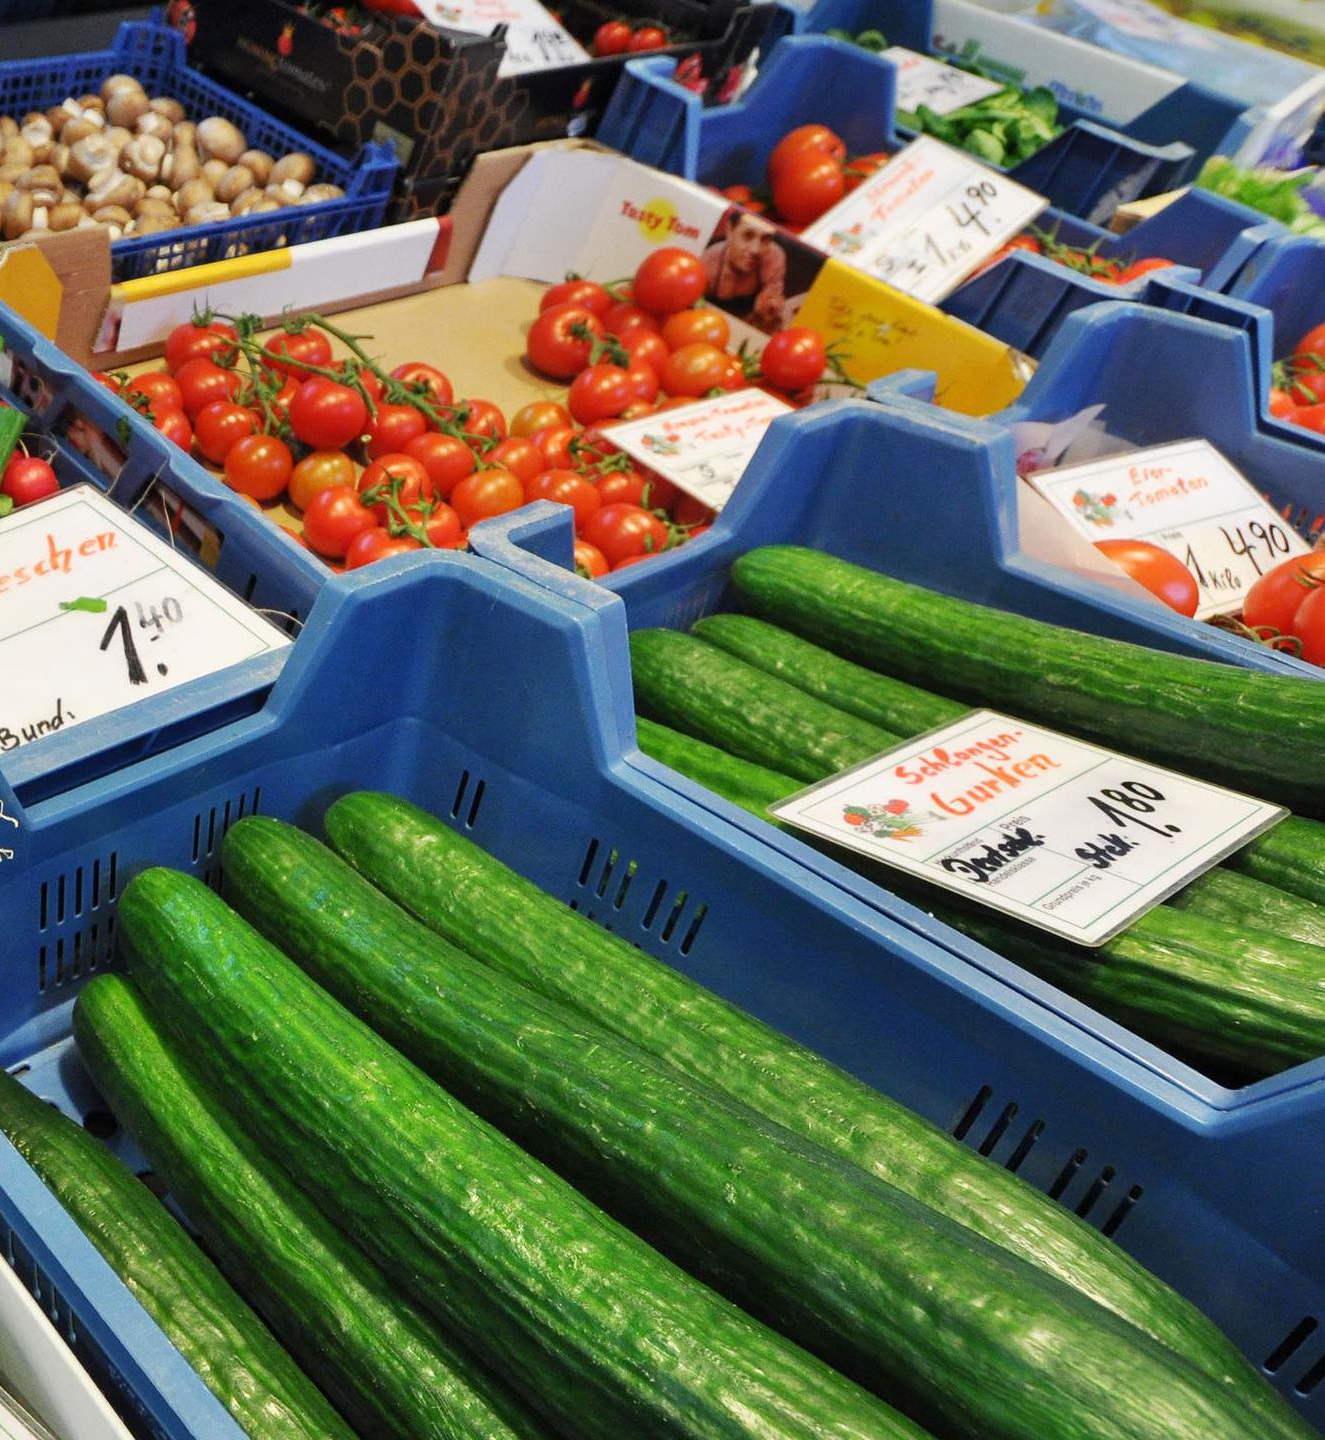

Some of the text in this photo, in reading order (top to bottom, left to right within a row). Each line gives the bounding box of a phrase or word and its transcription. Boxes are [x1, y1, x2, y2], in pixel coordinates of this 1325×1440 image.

[620, 200, 701, 240] Tasty Tom
[1128, 475, 1209, 509] Tomaten
[929, 753, 1062, 817] Gurken
[998, 814, 1032, 832] Preis
